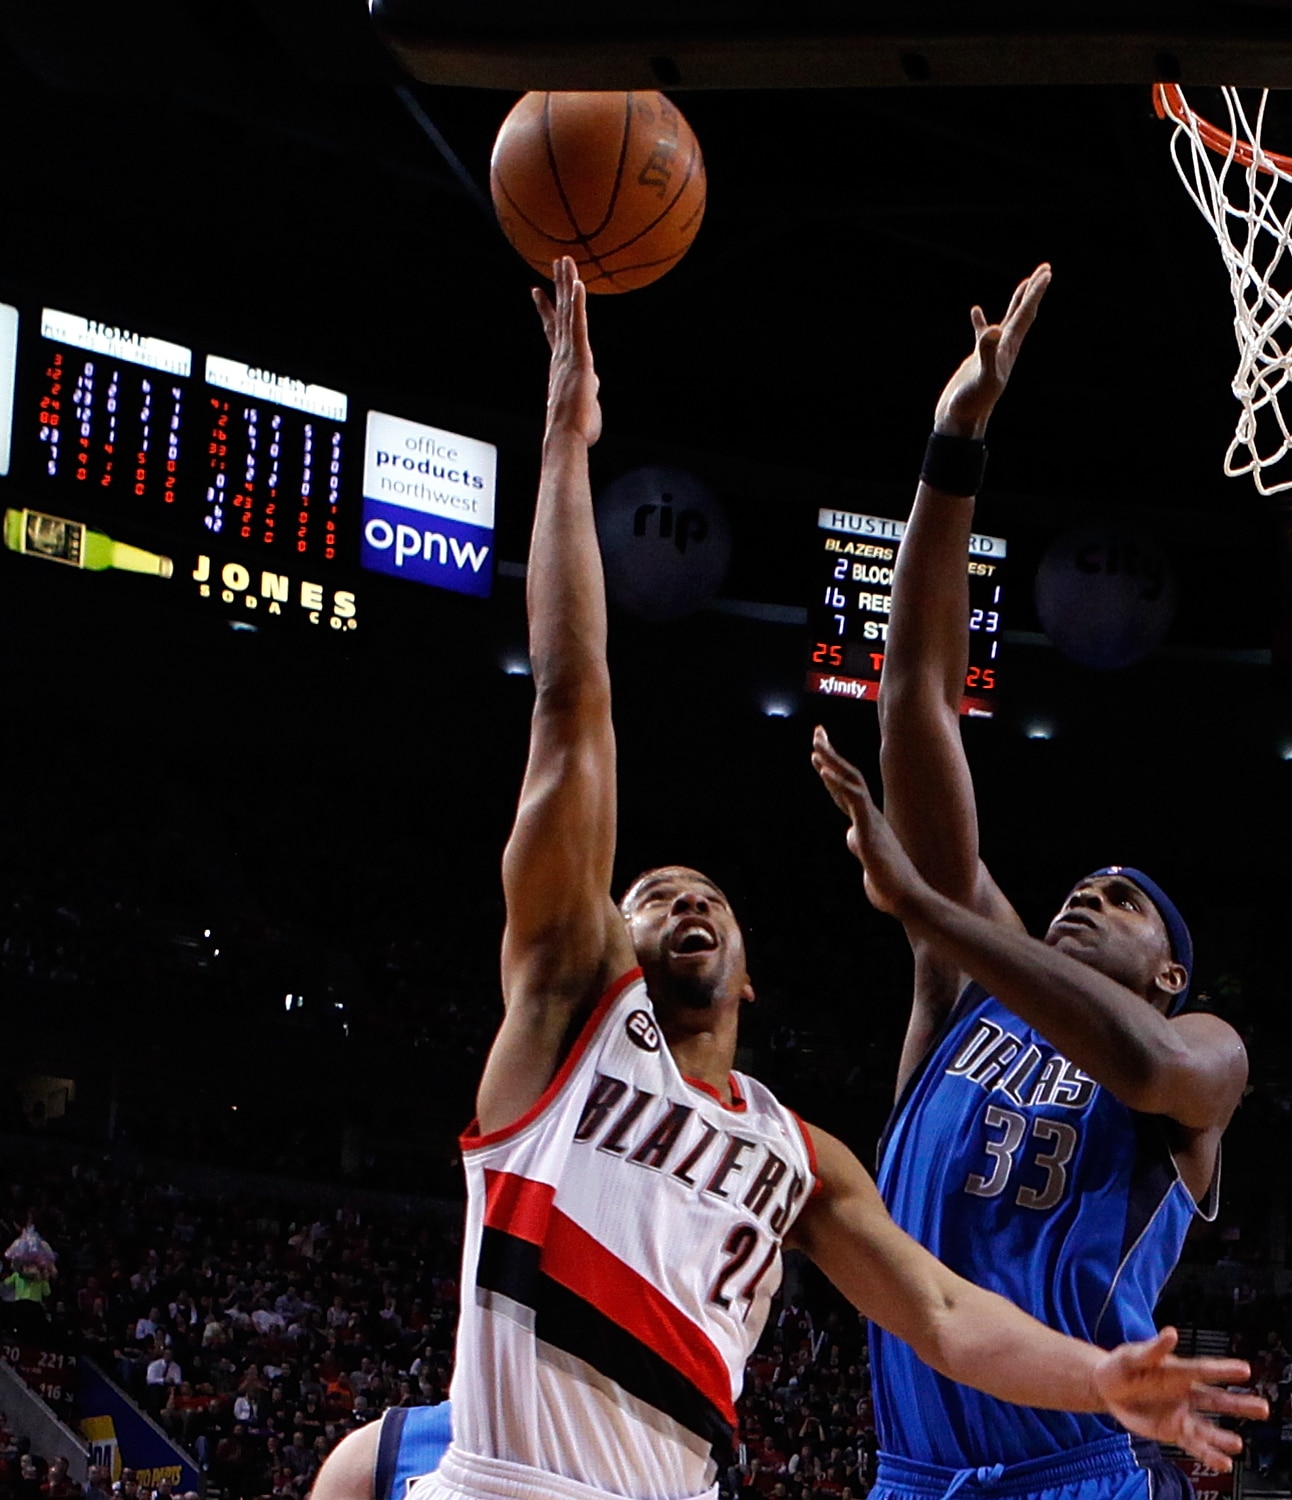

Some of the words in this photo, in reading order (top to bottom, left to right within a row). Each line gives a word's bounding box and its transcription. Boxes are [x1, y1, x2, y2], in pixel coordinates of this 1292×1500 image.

[376, 450, 484, 490] products
[405, 435, 458, 462] office
[380, 475, 478, 513] northwest
[365, 519, 489, 573] opnw
[634, 493, 708, 556] rip
[831, 512, 907, 537] HUSTL
[825, 538, 894, 561] BLAZERS
[968, 562, 996, 577] EST
[193, 555, 356, 618] JONES
[834, 558, 848, 579] 2
[852, 563, 894, 585] BLOC
[994, 586, 1000, 604] 1
[825, 586, 846, 608] 16
[969, 609, 999, 632] 23
[834, 614, 845, 636] 7
[991, 641, 997, 659] 1
[812, 643, 842, 666] 25
[966, 667, 995, 689] 25
[819, 677, 866, 698] xfinity
[629, 1012, 658, 1049] 20
[946, 1017, 1097, 1109] DALAS
[573, 1073, 803, 1237] BLAZERS
[965, 1104, 1077, 1211] 33
[38, 1352, 64, 1369] 221
